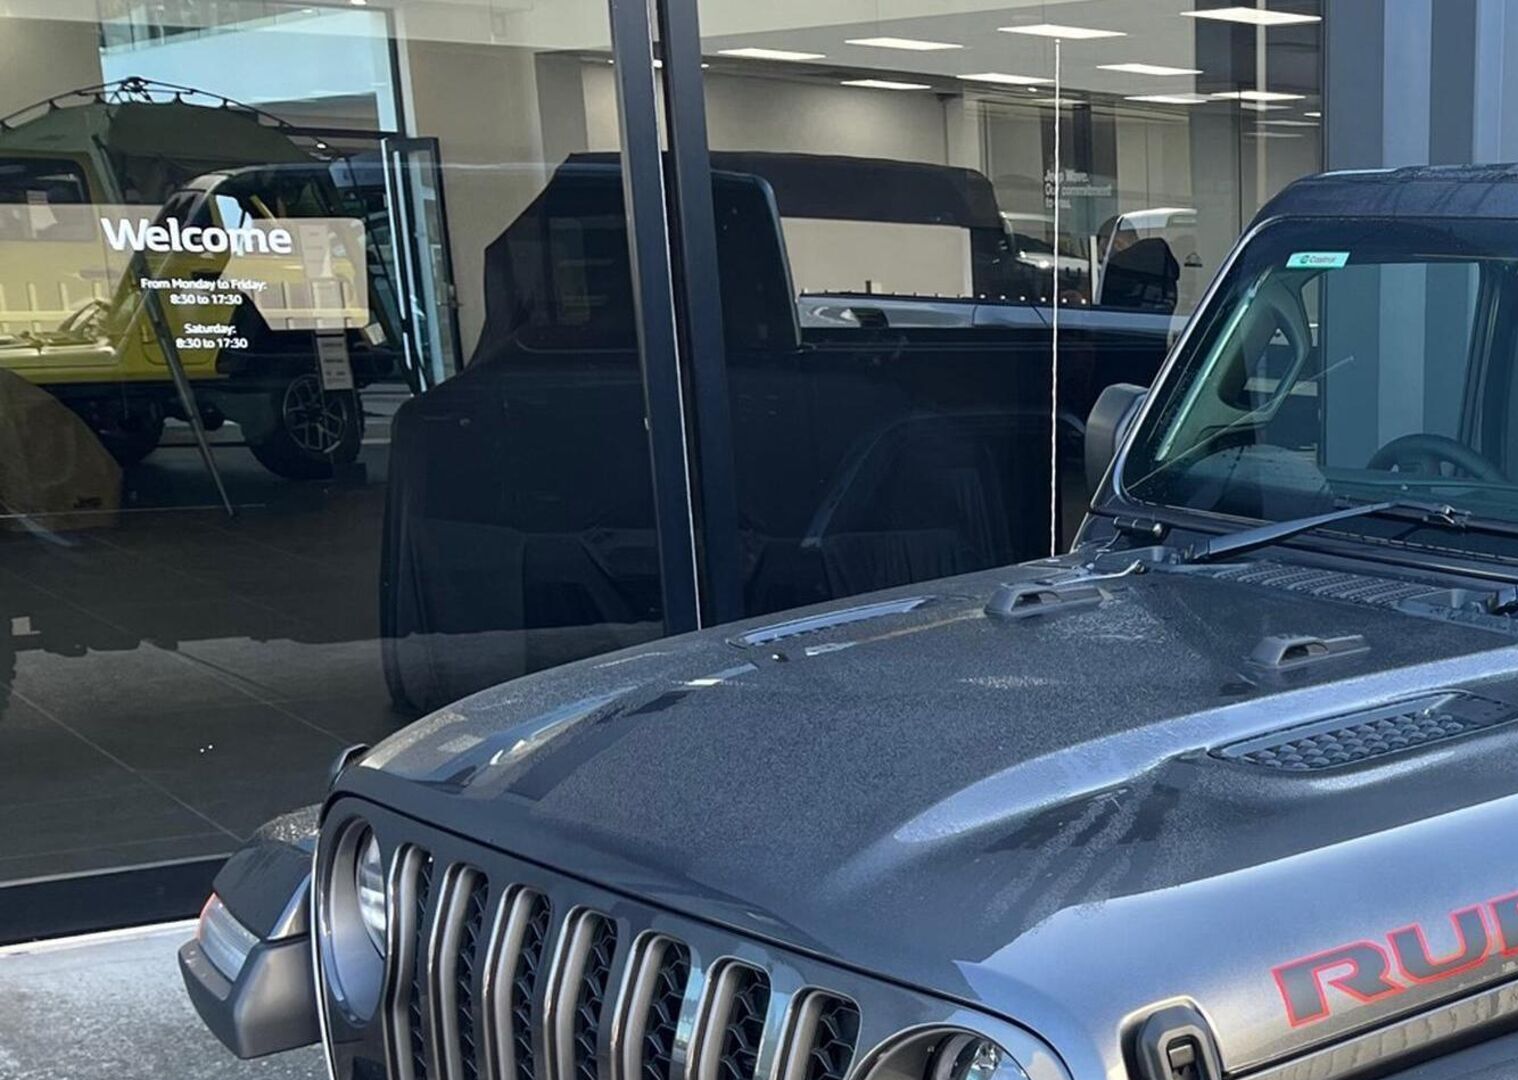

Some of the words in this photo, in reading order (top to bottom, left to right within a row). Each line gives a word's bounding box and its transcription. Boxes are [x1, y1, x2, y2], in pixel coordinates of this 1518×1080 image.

[100, 217, 292, 253] Welcome
[140, 278, 171, 290] From
[172, 278, 216, 291] Monday
[217, 279, 229, 290] to
[231, 279, 268, 291] Friday:
[170, 294, 196, 305] 8:30
[197, 294, 209, 305] to
[212, 294, 243, 305] 17:30
[184, 323, 237, 335] Saturday:
[175, 338, 201, 349] 8:30
[202, 339, 215, 349] to
[218, 338, 248, 349] 17:30
